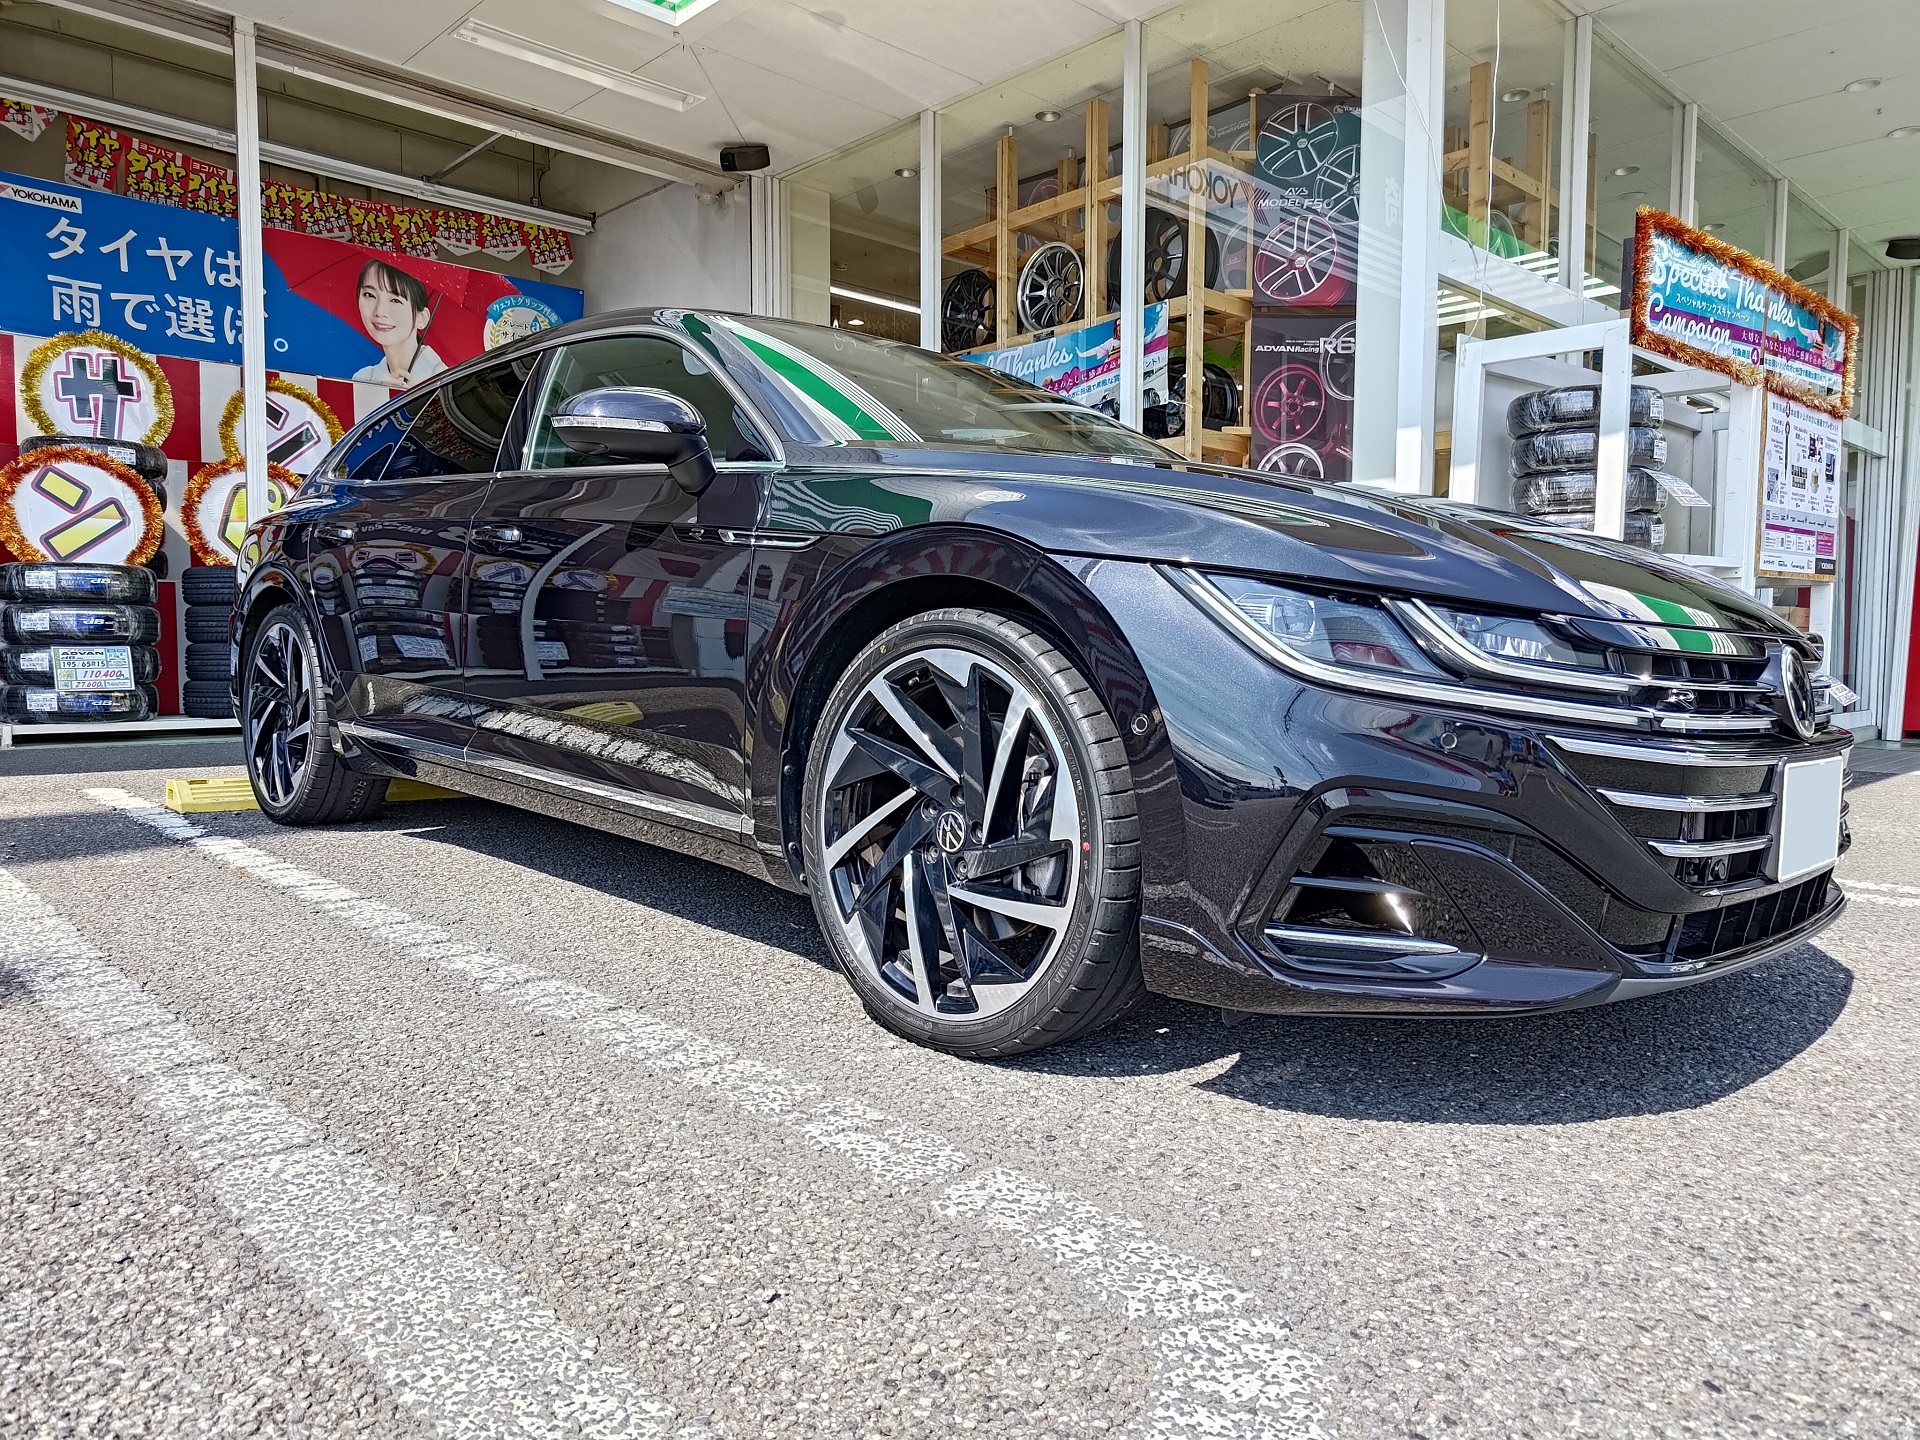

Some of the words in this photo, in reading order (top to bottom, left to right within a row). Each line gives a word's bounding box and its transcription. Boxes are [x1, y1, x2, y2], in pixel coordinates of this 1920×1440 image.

[139, 142, 174, 158] ヨコハマ
[126, 148, 187, 181] タイヤ
[192, 162, 227, 176] ヨコハマ
[11, 187, 79, 210] YOKOHAMA
[263, 185, 296, 205] イヤ
[1257, 198, 1302, 208] MODEL
[1302, 198, 1335, 210] F50
[46, 215, 268, 293] タイヤは
[1675, 293, 1751, 323] スペシャルサンクスキャンペーン
[1727, 264, 1797, 328] Thanks
[492, 297, 559, 324] ウェットグリップ性能
[1647, 291, 1733, 354] Campaign
[502, 319, 530, 331] グレード
[996, 338, 1074, 377] Thanks
[1294, 344, 1320, 354] Racing
